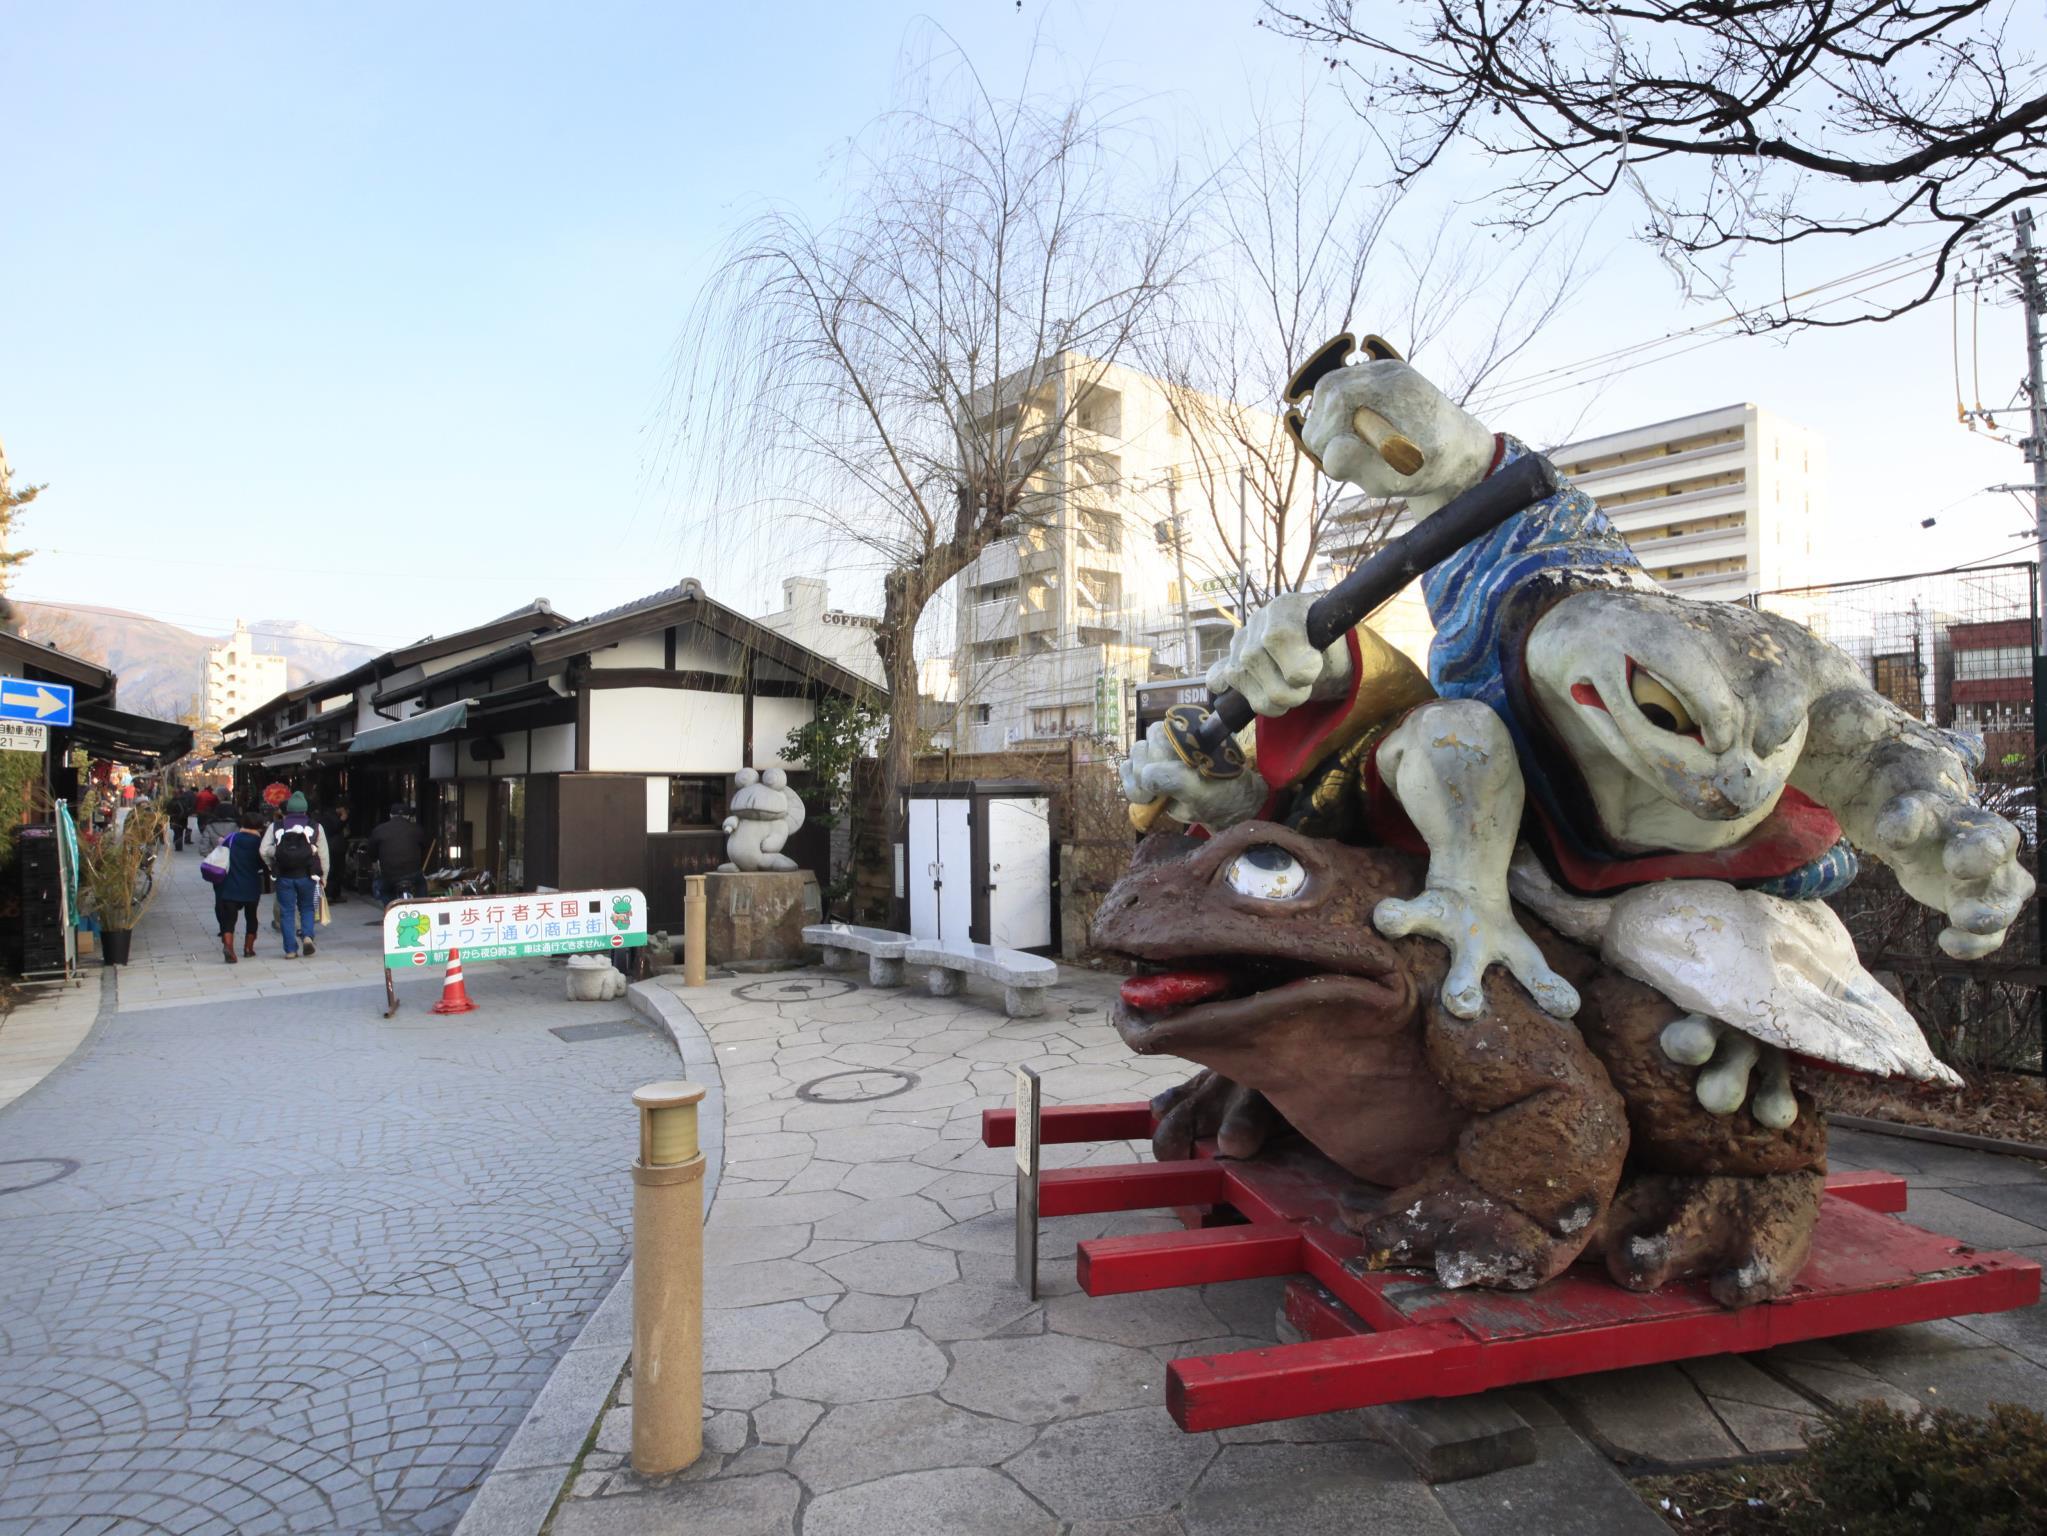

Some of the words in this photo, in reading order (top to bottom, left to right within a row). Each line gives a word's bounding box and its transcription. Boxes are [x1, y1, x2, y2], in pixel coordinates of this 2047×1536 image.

[1177, 688, 1208, 703] ISDN
[460, 900, 578, 925] 歩行者天国
[436, 918, 603, 946] ナワテ通り商店街
